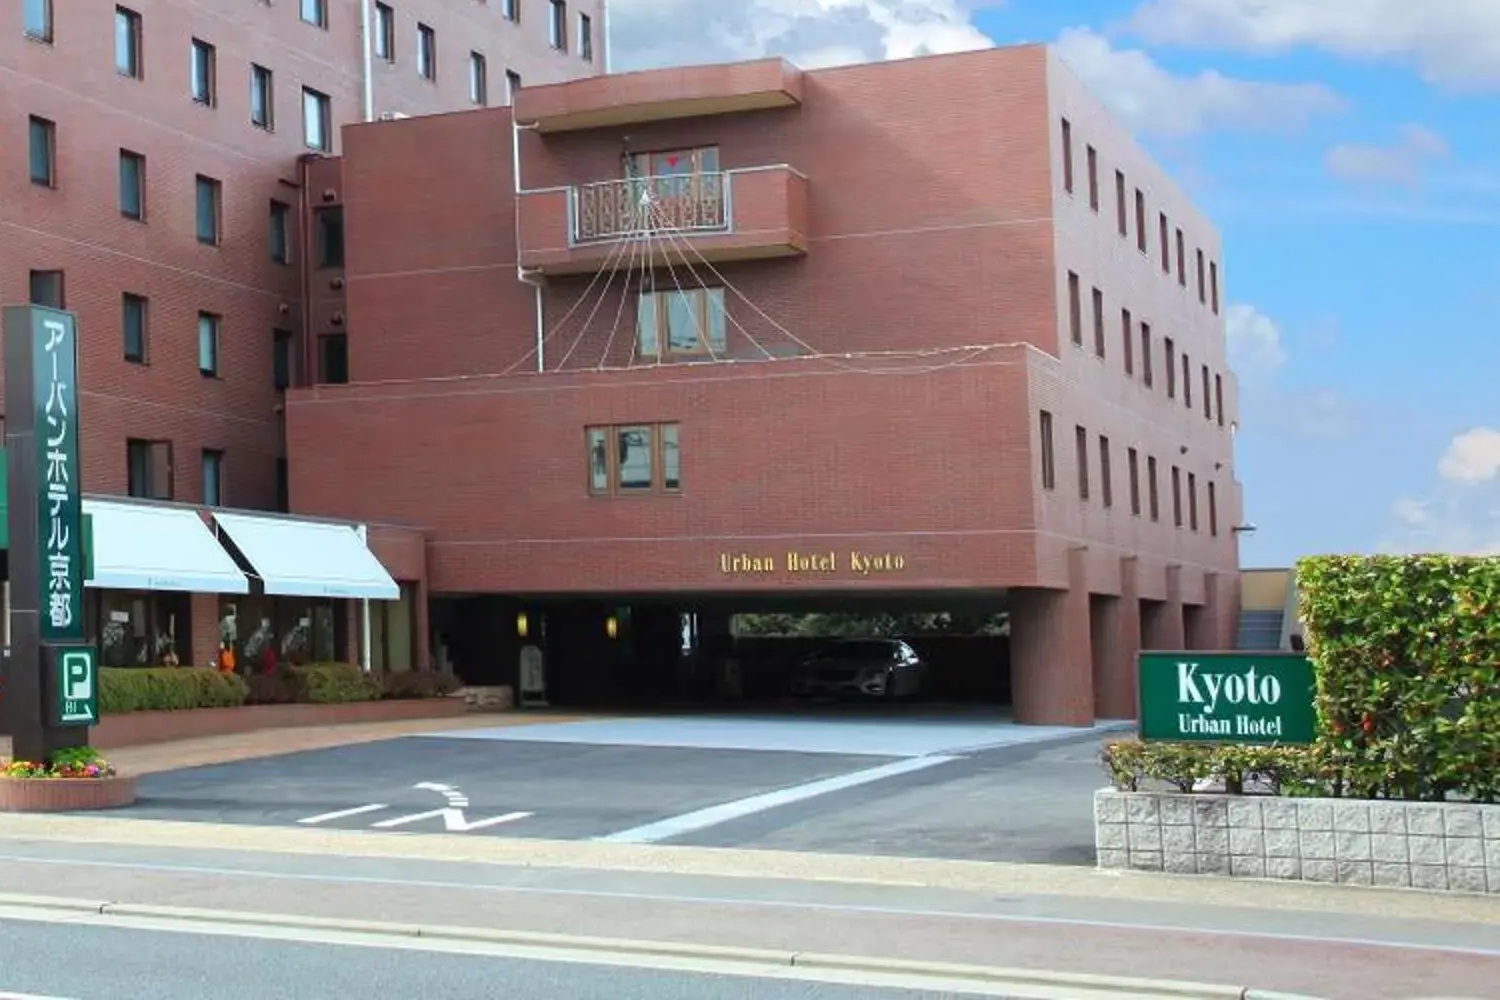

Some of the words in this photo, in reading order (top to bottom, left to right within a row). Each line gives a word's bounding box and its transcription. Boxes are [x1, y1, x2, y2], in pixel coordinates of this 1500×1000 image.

[43, 319, 72, 628] アーバンホテル京都
[721, 553, 774, 572] Urban
[787, 552, 836, 571] Hotel
[851, 551, 905, 575] Kyoto
[1177, 662, 1281, 714] Kyoto
[1178, 713, 1231, 734] Urban
[1236, 714, 1282, 735] Hotel
